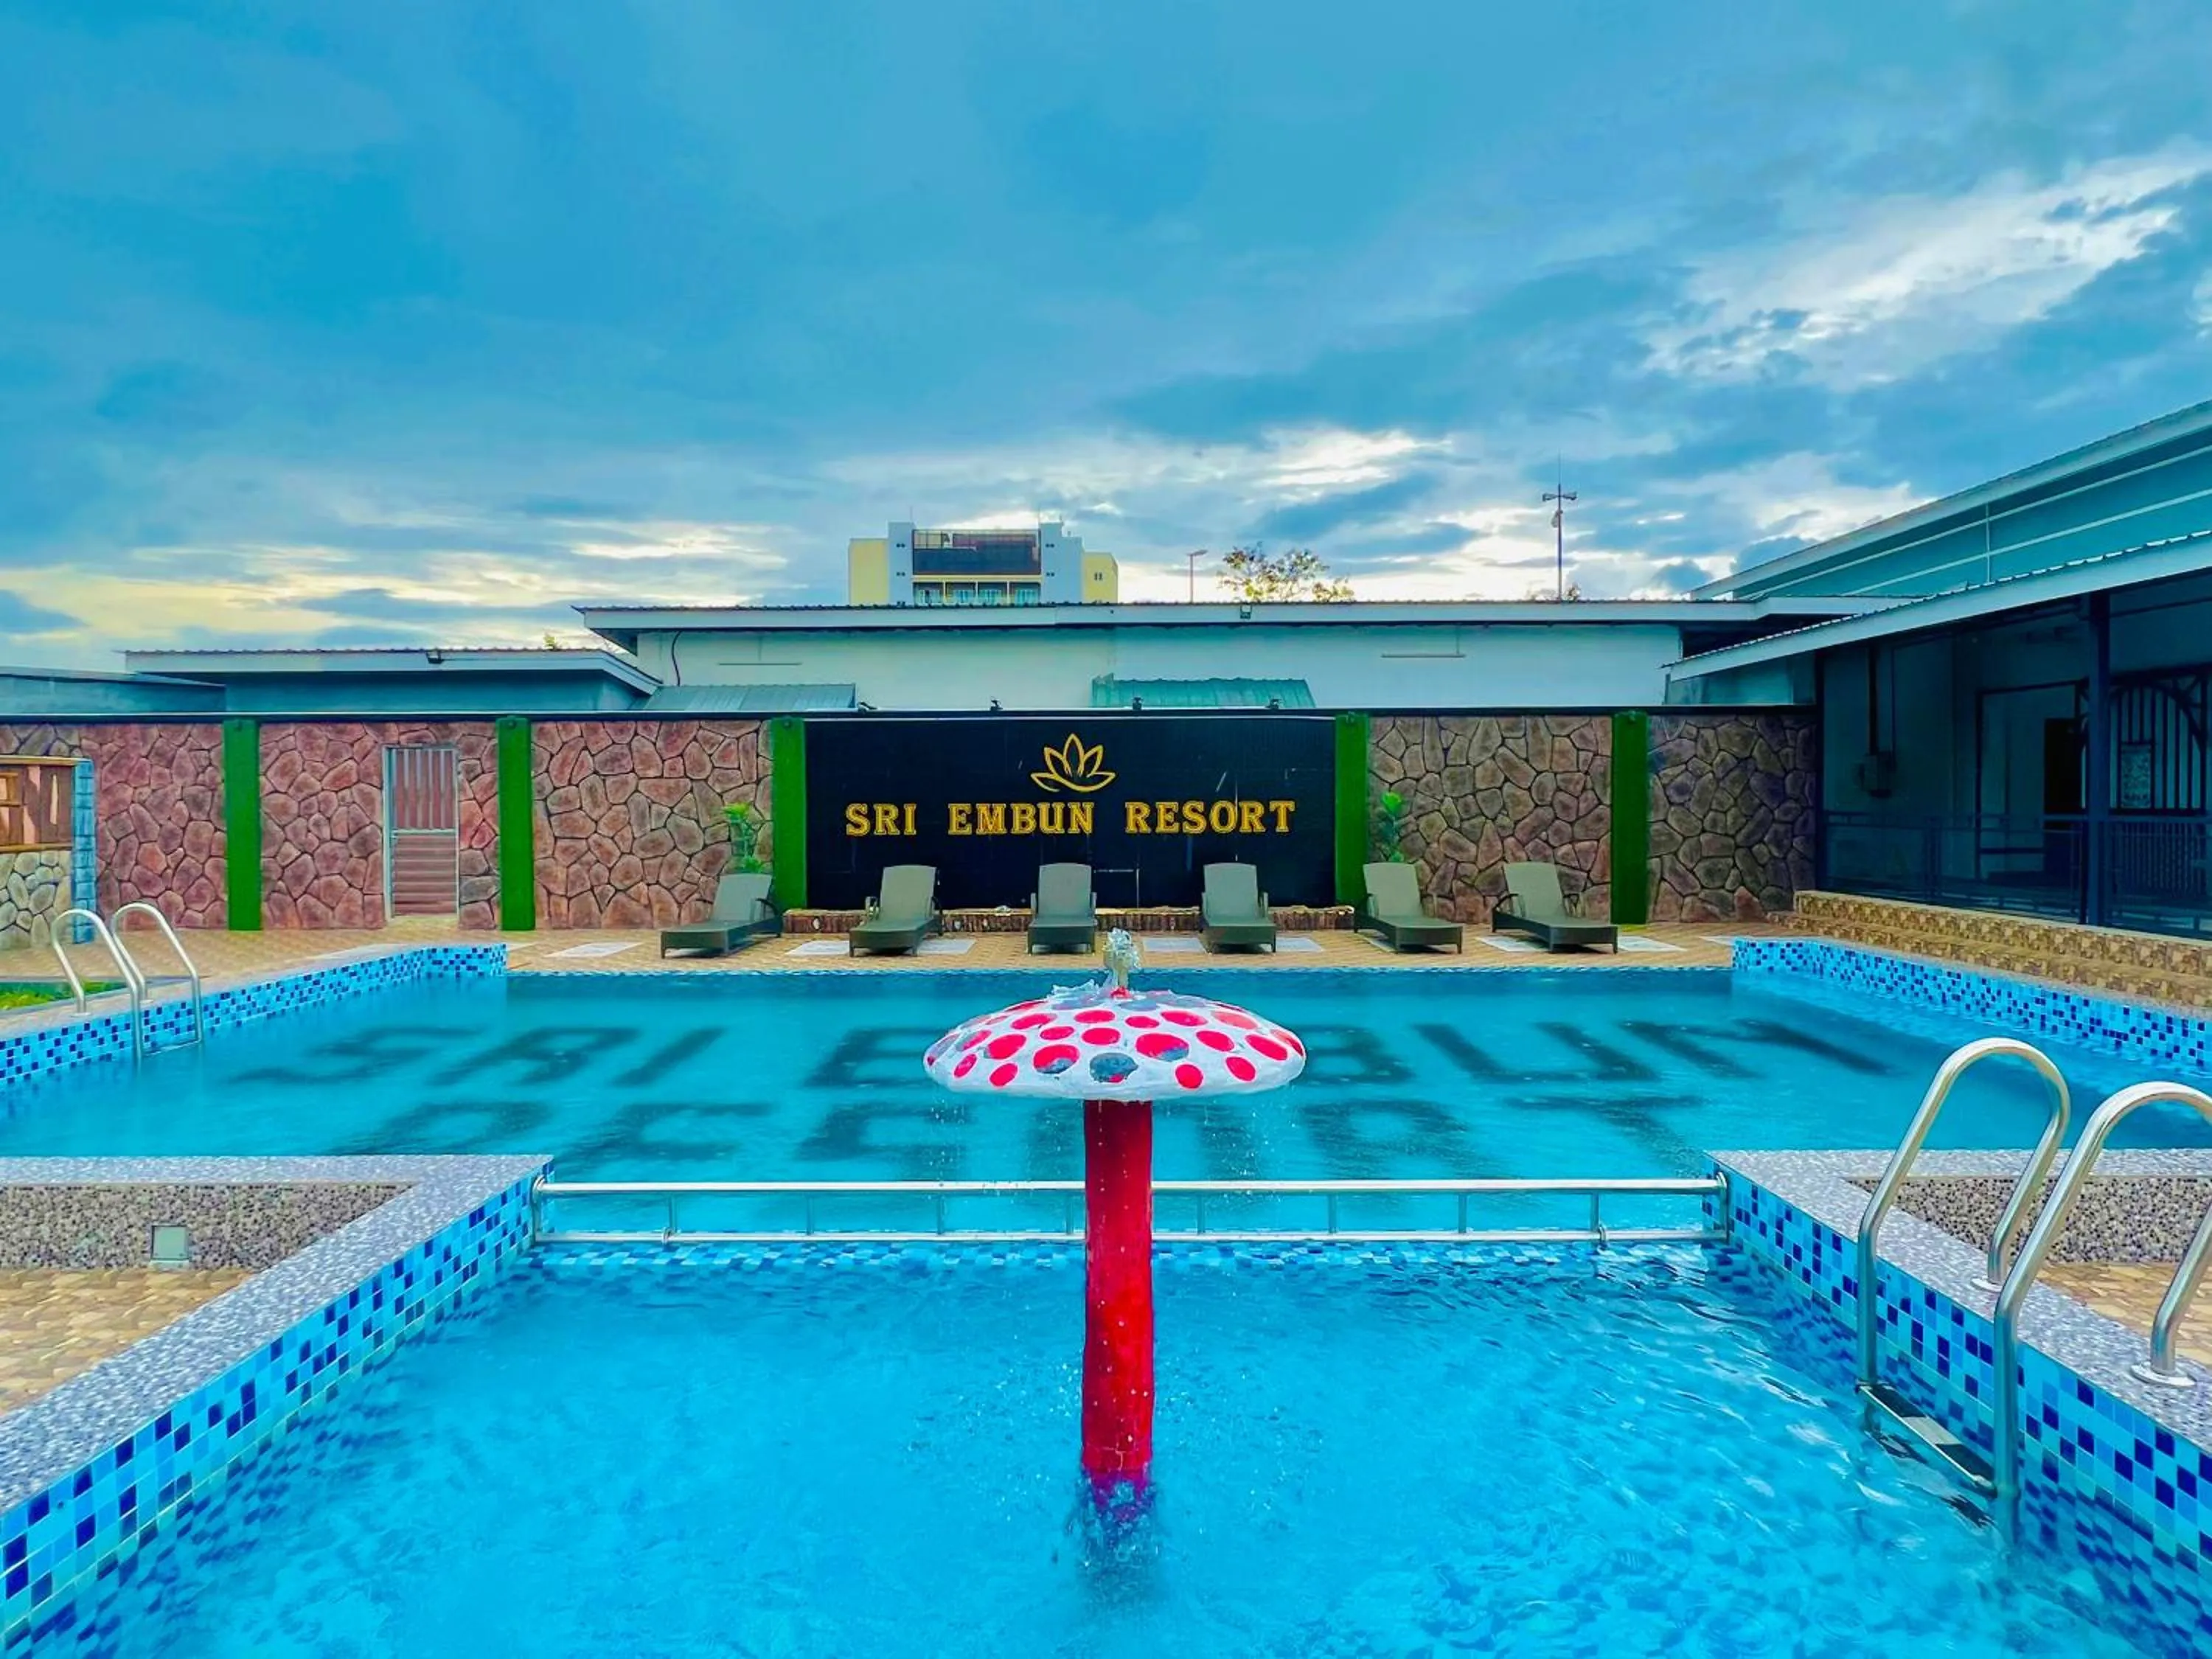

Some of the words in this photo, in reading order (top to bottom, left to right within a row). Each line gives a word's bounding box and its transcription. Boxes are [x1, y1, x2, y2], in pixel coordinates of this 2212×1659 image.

[845, 803, 917, 836] SRI
[947, 801, 1094, 835] EMBUN
[1124, 800, 1295, 834] RESORT
[227, 1025, 731, 1088] SRI
[798, 1018, 1899, 1089] EBUN
